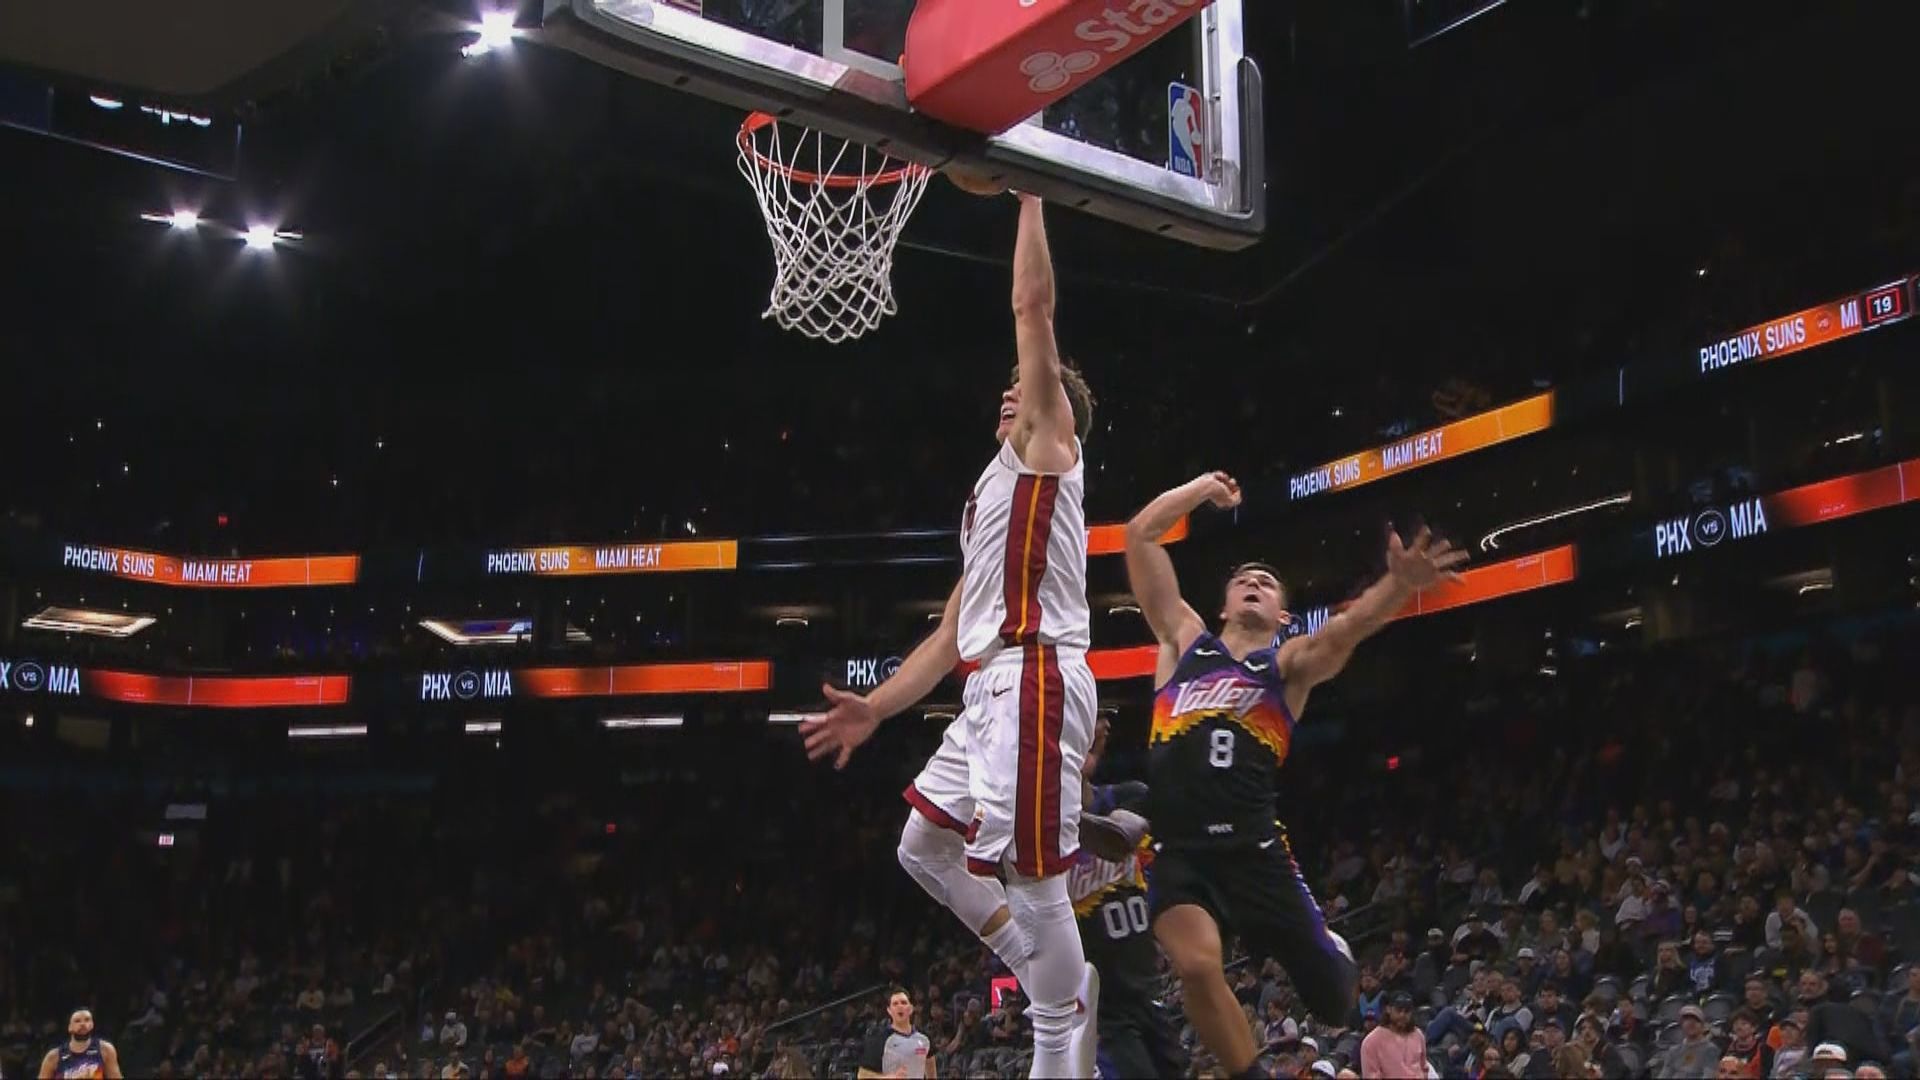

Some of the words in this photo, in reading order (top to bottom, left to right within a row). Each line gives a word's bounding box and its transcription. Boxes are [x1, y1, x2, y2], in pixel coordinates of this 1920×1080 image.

[1174, 155, 1192, 176] NBA
[1873, 296, 1891, 315] 19
[1700, 332, 1763, 373] PHOENIX
[1766, 317, 1806, 352] SUNS
[1290, 468, 1331, 500] PHOENIX
[1334, 458, 1361, 485] SUNS
[1383, 441, 1413, 471] MIAMI
[1415, 431, 1443, 460] HEAT
[1656, 517, 1692, 558] PHX
[1702, 521, 1719, 535] VS
[1730, 498, 1767, 539] MIA
[63, 545, 119, 571] PHOENIX
[122, 556, 155, 577] SUNS
[182, 562, 219, 582] MIAMI
[221, 564, 252, 583] HEAT
[488, 552, 537, 574] PHOENIX
[540, 551, 570, 571] SUNS
[596, 549, 629, 569] MIAMI
[631, 547, 661, 568] HEAT
[1306, 607, 1329, 639] MIA
[22, 671, 37, 682] VS
[48, 665, 80, 695] MIA
[422, 673, 451, 700] PHX
[460, 680, 474, 690] VS
[484, 671, 512, 698] MIA
[847, 658, 878, 686] PHX
[1170, 678, 1266, 719] Valley
[1209, 729, 1235, 767] 8
[1103, 895, 1149, 940] 00
